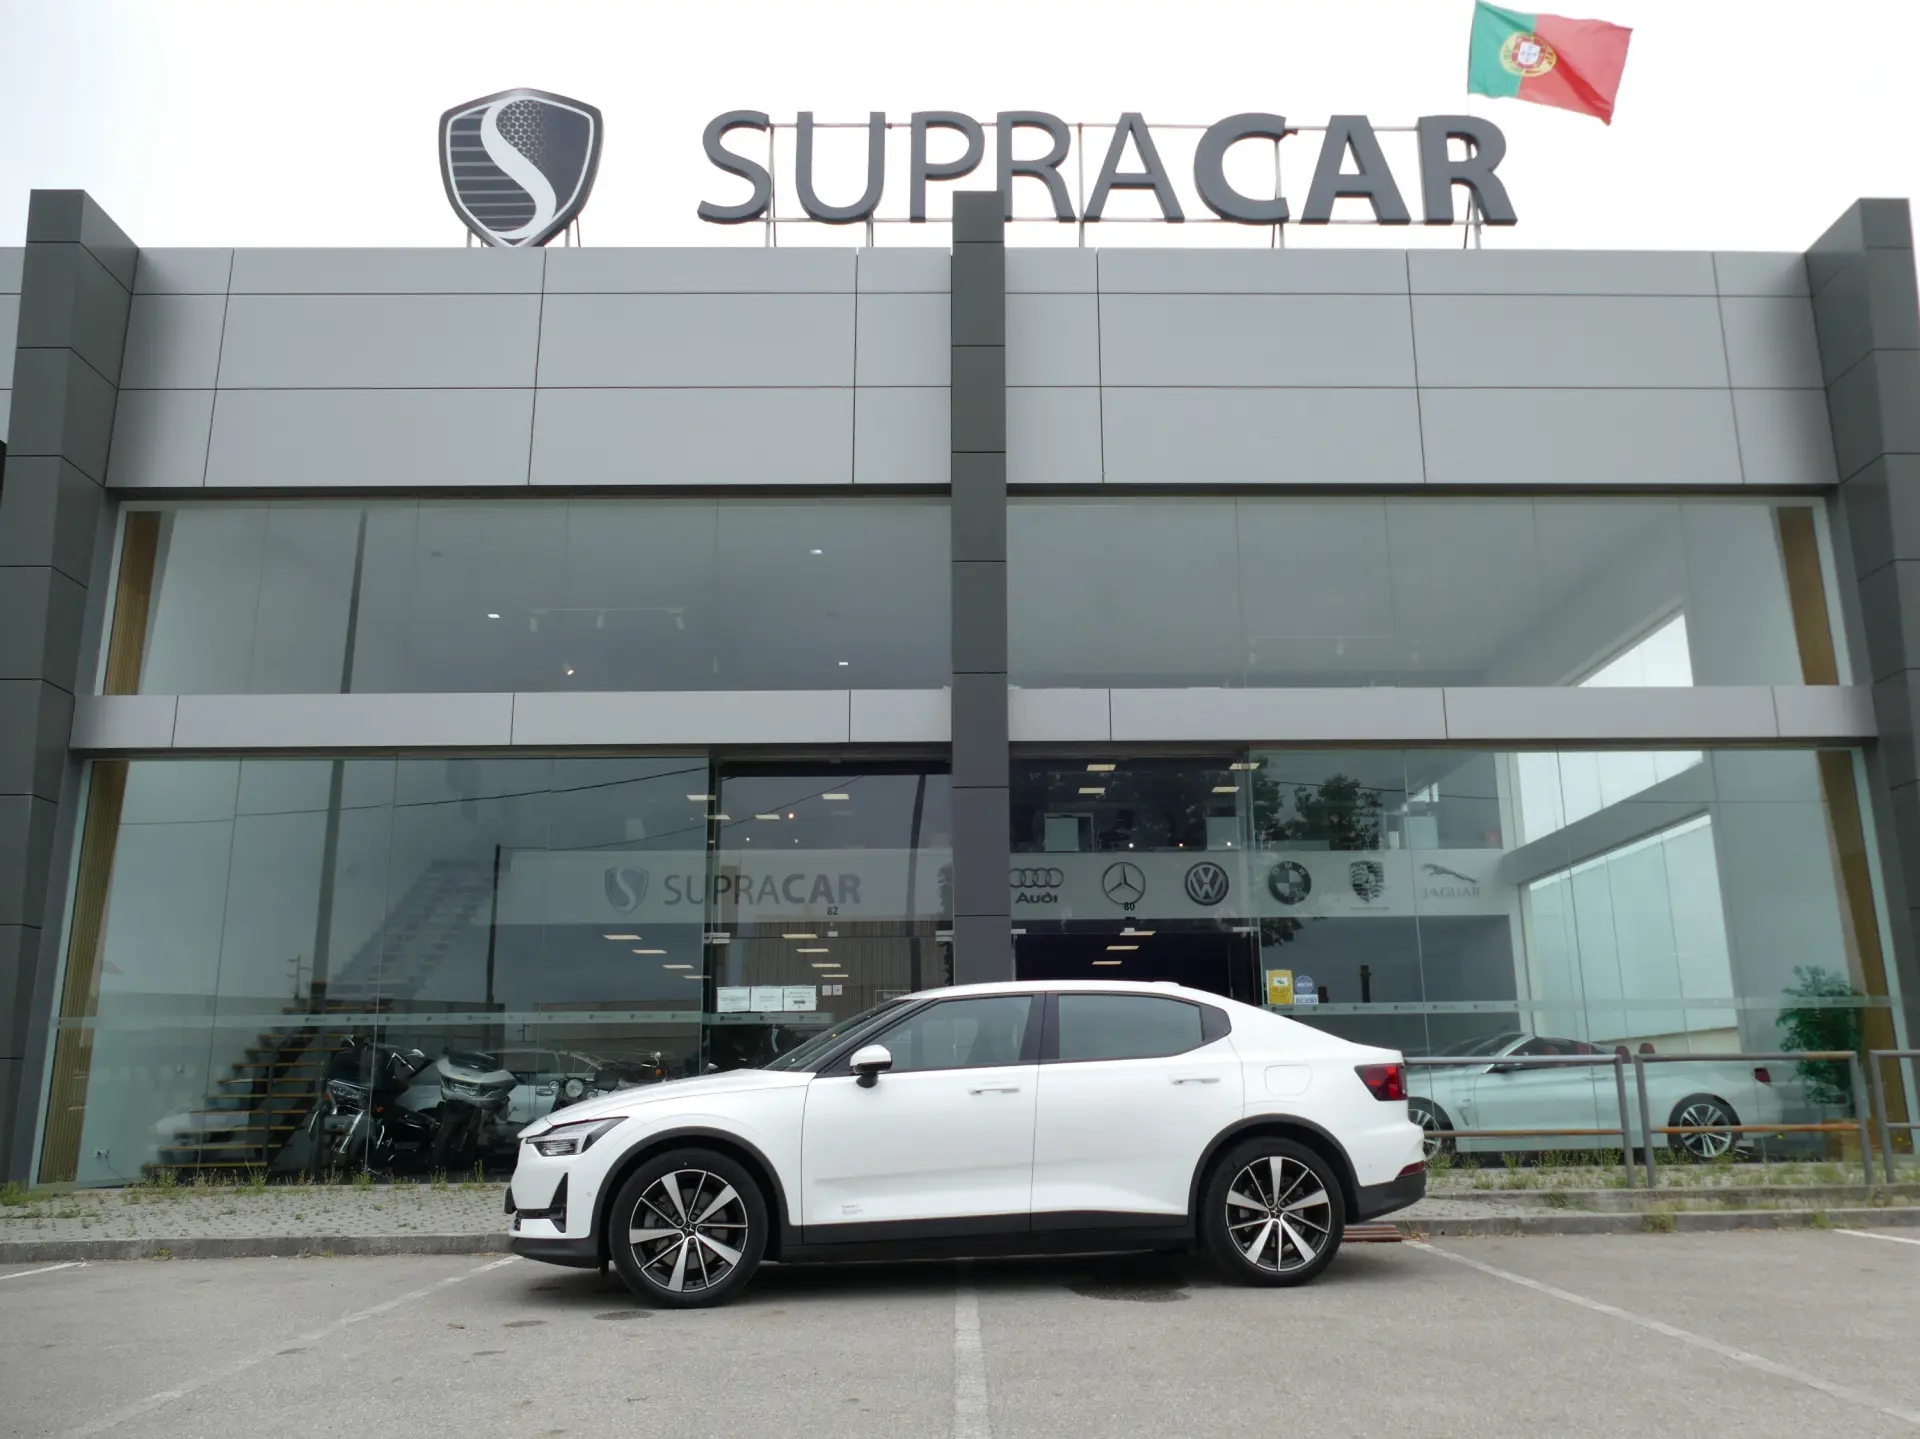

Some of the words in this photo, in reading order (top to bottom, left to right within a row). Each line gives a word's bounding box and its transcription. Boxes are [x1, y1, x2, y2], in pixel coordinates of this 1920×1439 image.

[697, 109, 1518, 226] SUPRACAR
[663, 873, 862, 905] SUPRACAR
[1423, 886, 1481, 899] JAGUAR
[1015, 891, 1058, 904] Audi
[1123, 902, 1136, 911] 80
